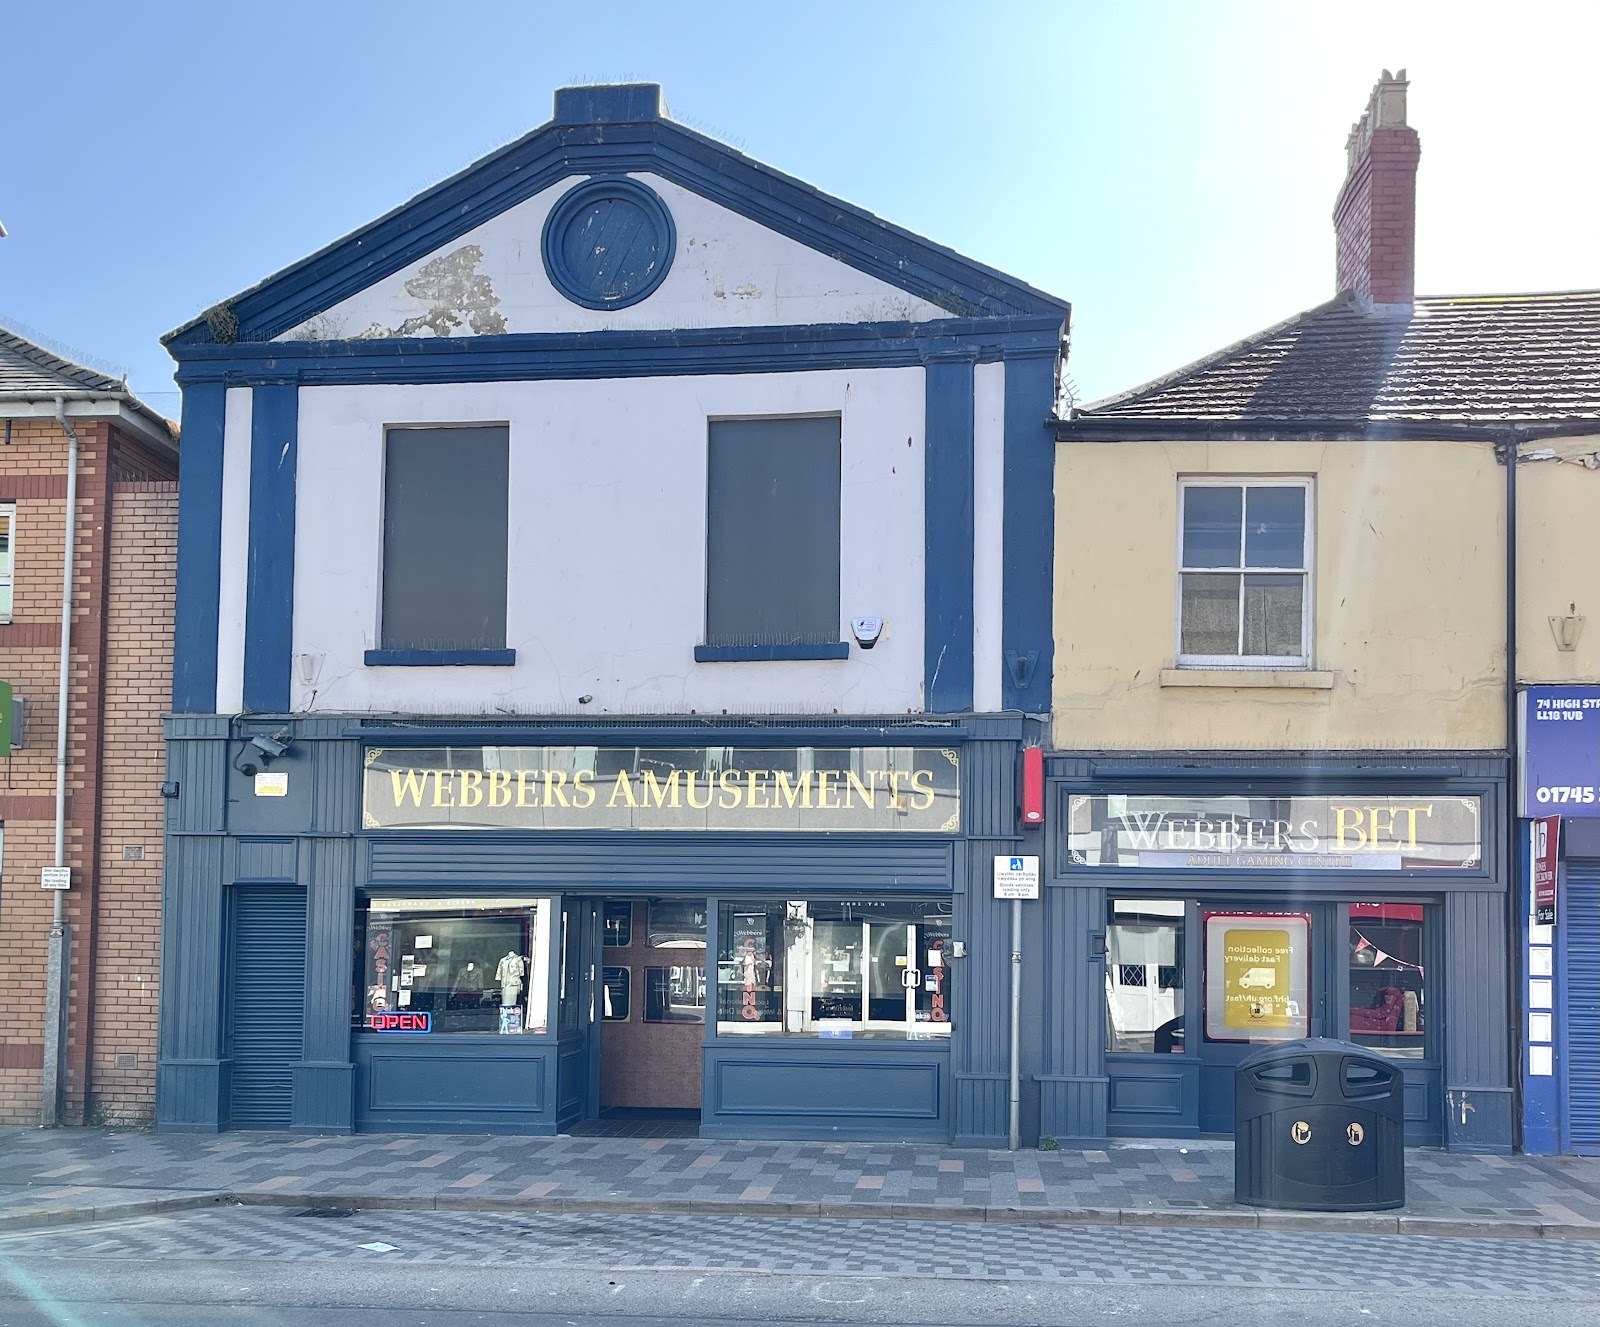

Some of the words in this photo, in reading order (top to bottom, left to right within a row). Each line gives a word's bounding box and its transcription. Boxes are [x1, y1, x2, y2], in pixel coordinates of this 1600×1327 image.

[1537, 699, 1550, 709] 74
[1552, 699, 1580, 709] HIGH
[1537, 711, 1560, 720] LL18
[1562, 711, 1583, 720] 1UB
[388, 769, 596, 808] WEBBERS
[606, 769, 935, 809] AMUSEMENTS
[1536, 786, 1595, 803] 01745
[1115, 810, 1319, 851] WEBBERS
[1330, 804, 1432, 851] BET
[1186, 855, 1232, 867] ADULT
[1236, 855, 1294, 867] GAMING
[1298, 855, 1353, 868] CENTRE
[1537, 909, 1545, 921] For
[1545, 908, 1554, 920] Sale
[370, 1014, 427, 1030] OPEN
